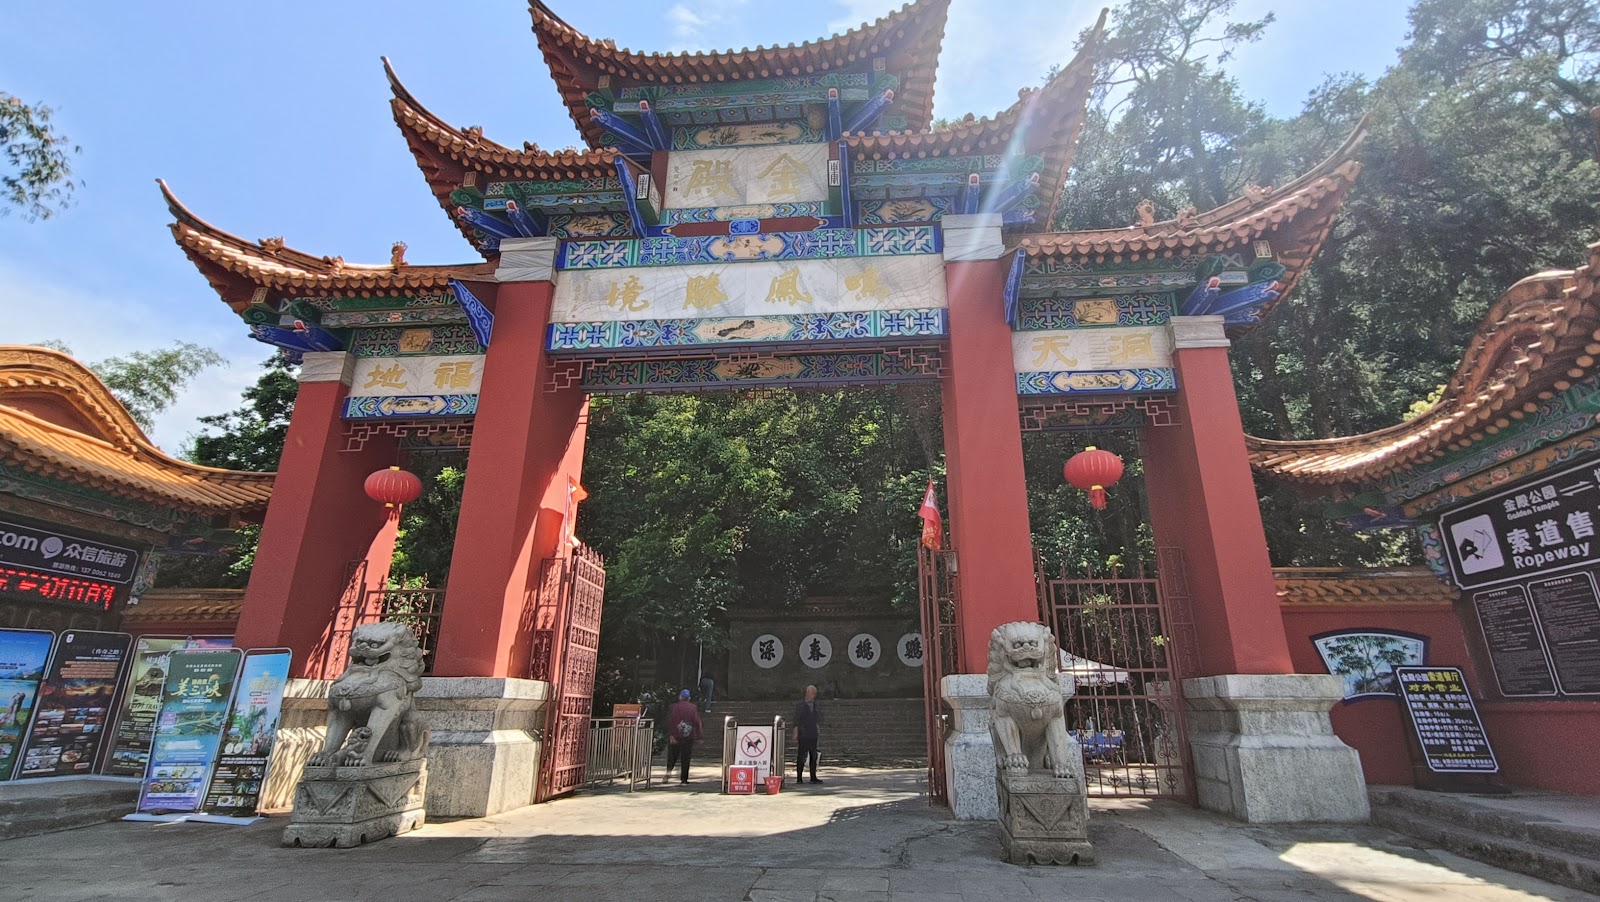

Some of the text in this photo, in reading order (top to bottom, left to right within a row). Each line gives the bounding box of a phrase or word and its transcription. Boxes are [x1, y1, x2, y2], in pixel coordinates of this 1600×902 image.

[1503, 484, 1557, 513] 金殿公园
[1506, 499, 1560, 521] Golden Temple
[63, 543, 128, 567] 众信旅游
[1513, 541, 1590, 569] Ropeway
